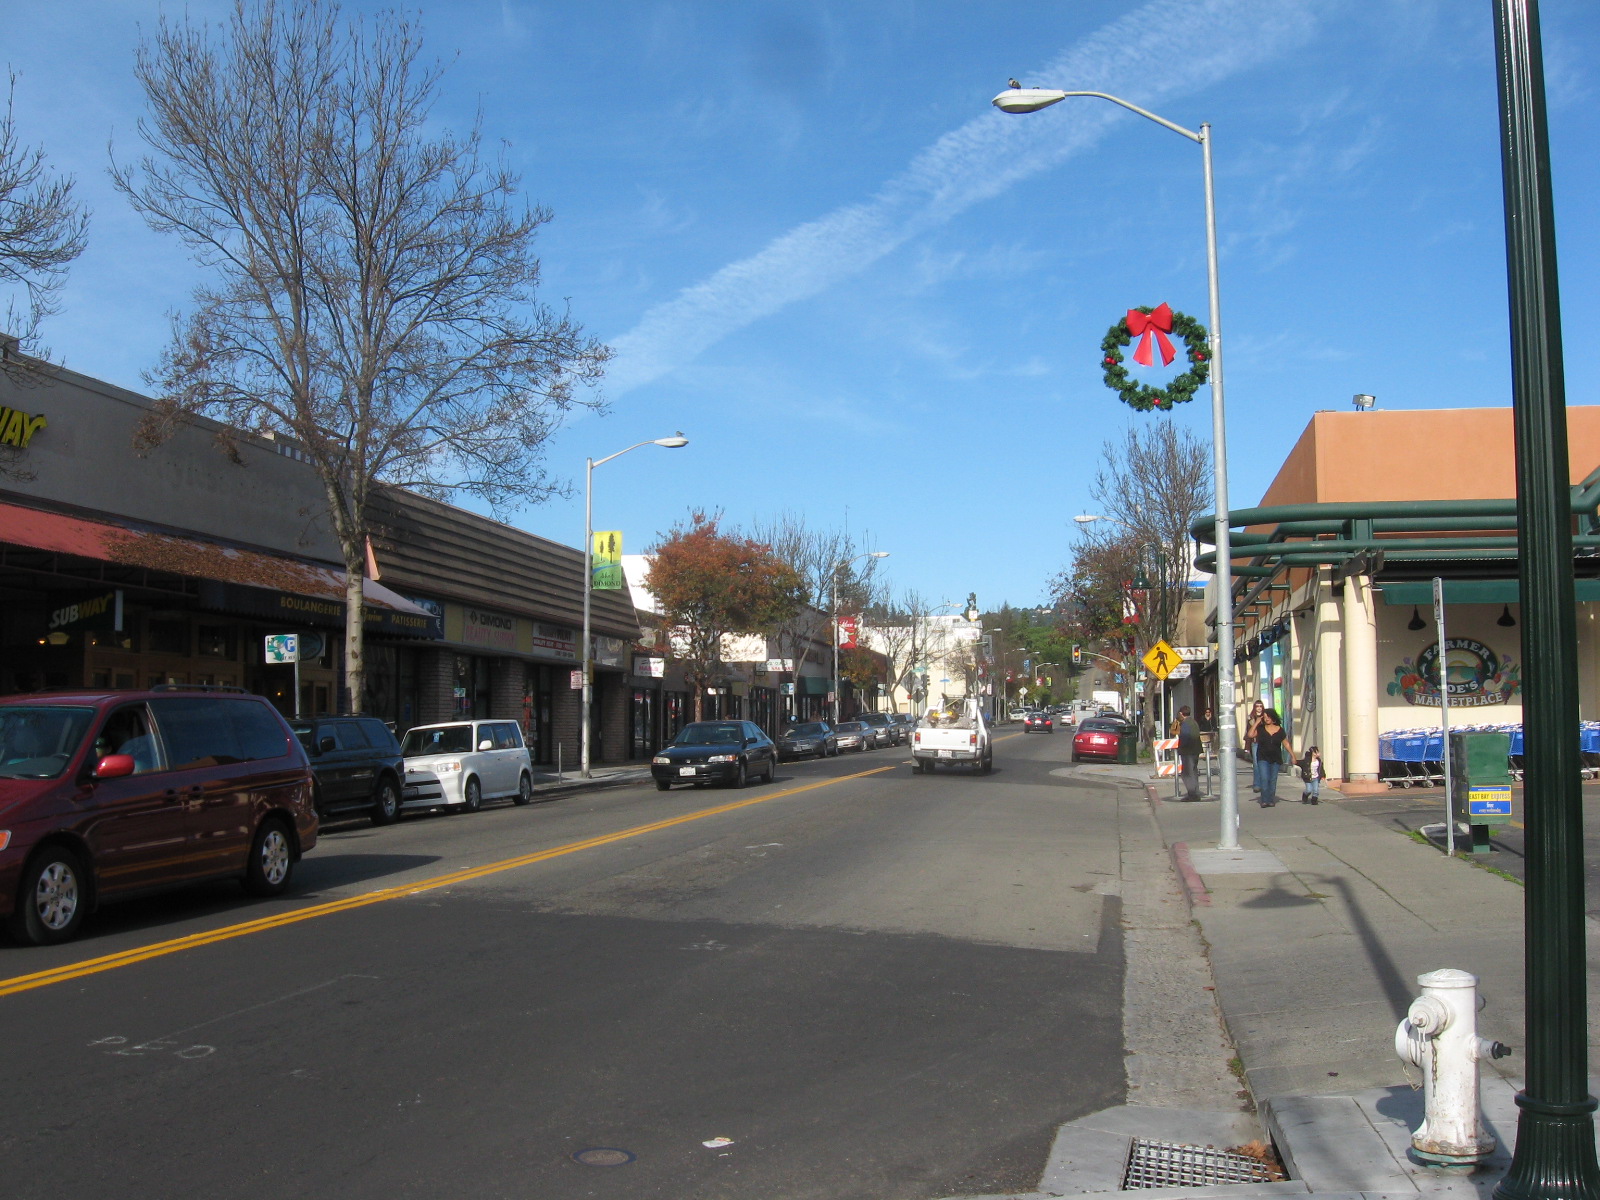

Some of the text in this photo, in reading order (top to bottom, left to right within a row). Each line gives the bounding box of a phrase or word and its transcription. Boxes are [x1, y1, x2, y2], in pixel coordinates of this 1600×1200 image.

[49, 593, 114, 629] SUBWAY
[280, 596, 341, 616] BOULANGERIE
[391, 614, 428, 629] PATISSERIE
[480, 613, 512, 631] DIMOND
[1423, 640, 1490, 660] FARMER
[1437, 680, 1479, 694] OE'S
